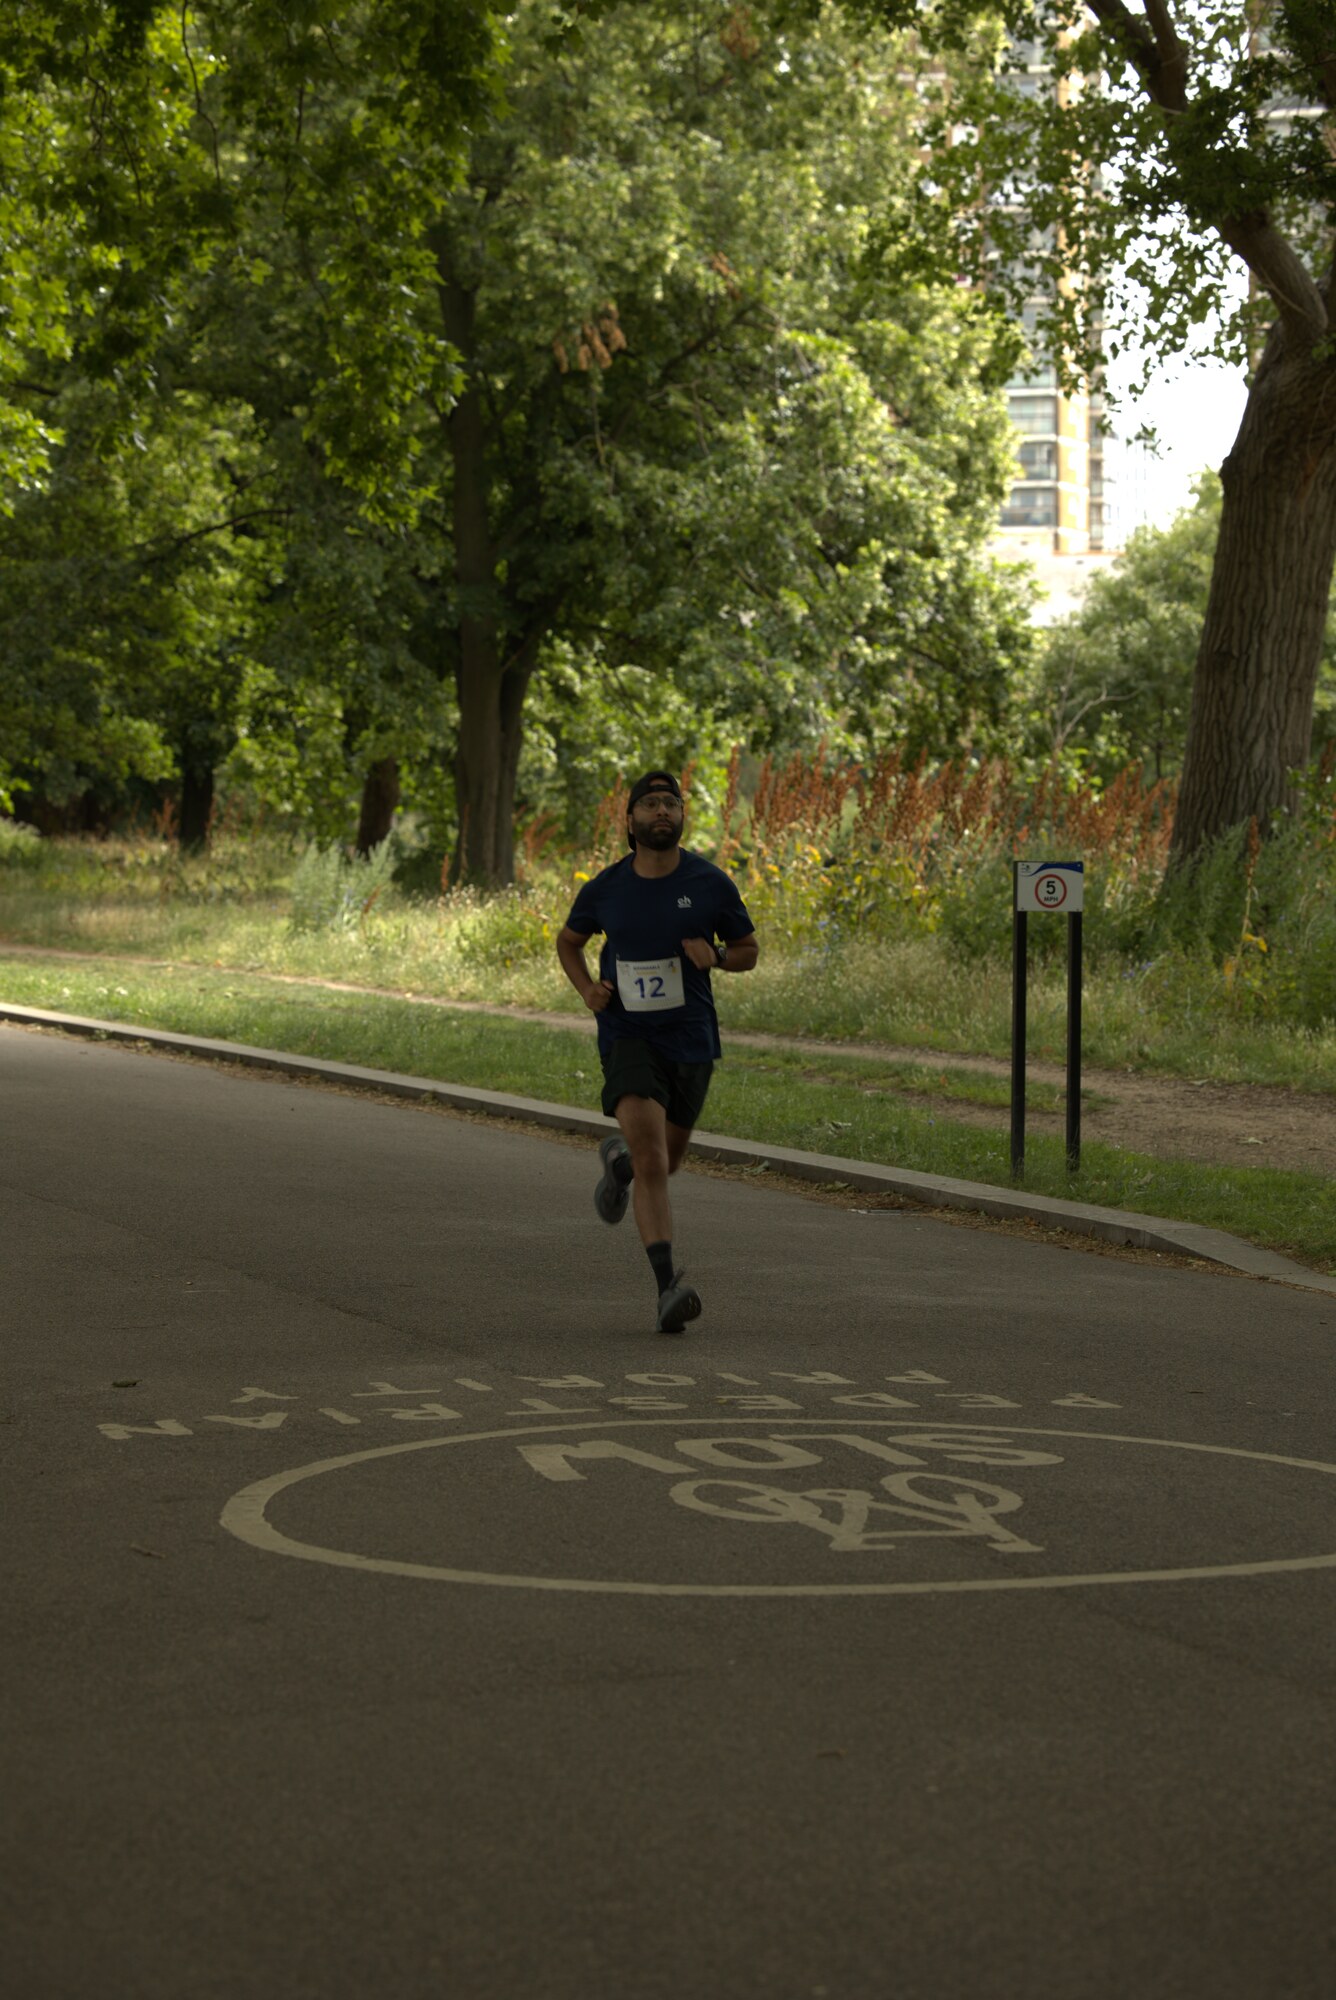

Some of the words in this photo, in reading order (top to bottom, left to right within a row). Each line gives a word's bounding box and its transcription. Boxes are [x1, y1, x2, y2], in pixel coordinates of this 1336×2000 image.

[1046, 881, 1056, 895] 5
[634, 976, 666, 998] 12
[231, 1370, 949, 1403] PRIORITY
[98, 1393, 1122, 1440] PEDESTRIAN
[517, 1434, 1064, 1481] SLOW
